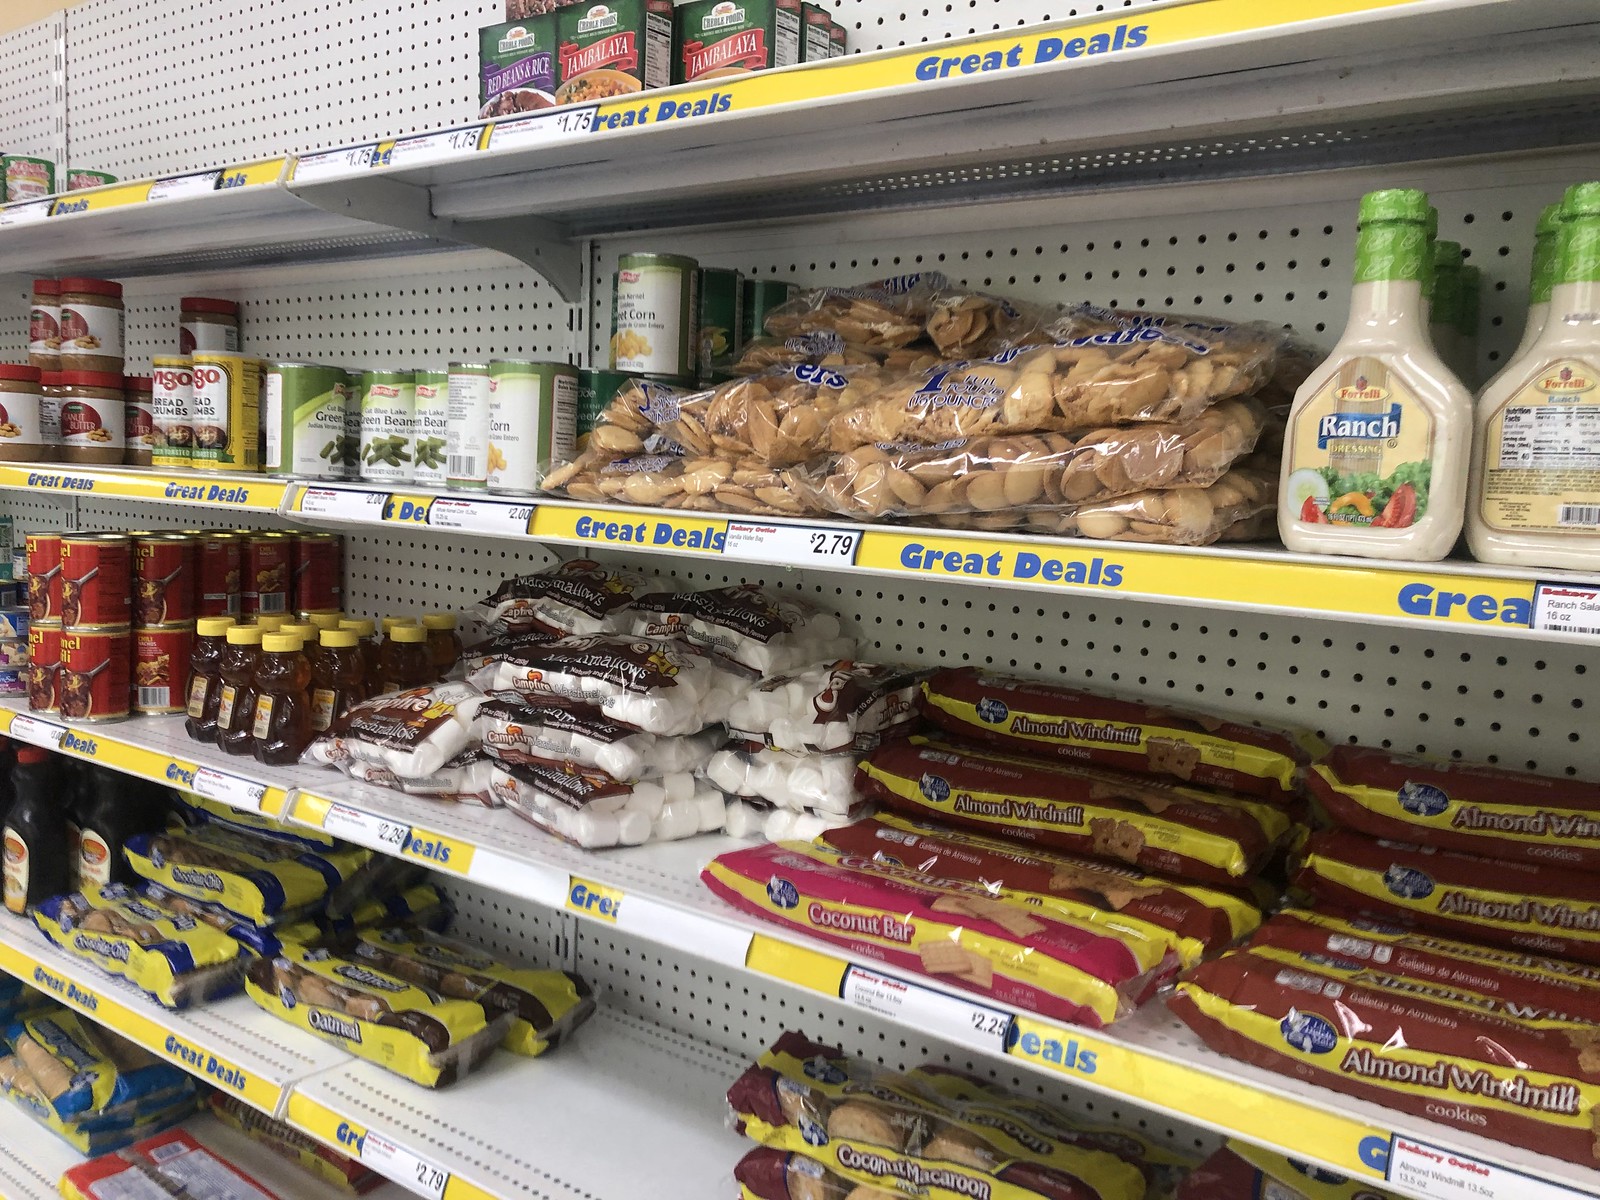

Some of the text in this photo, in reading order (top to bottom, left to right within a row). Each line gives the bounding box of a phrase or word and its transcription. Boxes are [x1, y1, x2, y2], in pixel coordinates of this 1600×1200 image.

[567, 36, 629, 79] JAMBALAYA
[691, 33, 757, 77] JAMBALAYA
[915, 24, 1149, 81] Great Deals
[487, 75, 501, 94] RED
[502, 66, 523, 89] BEANS
[531, 57, 550, 78] RICE
[557, 111, 592, 133] $1.75
[591, 92, 732, 132] reat Deals
[448, 130, 478, 150] $1.75
[346, 149, 372, 166] $1.75
[218, 173, 248, 189] eals
[629, 309, 656, 321] Corn
[793, 363, 849, 389] ers
[154, 398, 184, 407] BREAD
[390, 408, 408, 416] Lake
[429, 409, 445, 417] Lake
[490, 418, 511, 432] Corn
[1321, 415, 1399, 438] Ranch
[28, 472, 94, 491] Great Deals
[165, 482, 249, 503] Great Deals
[575, 516, 727, 550] Great Deals
[731, 525, 754, 533] Bakery
[810, 533, 853, 556] $2.79
[900, 543, 1124, 587] Great Deals
[1398, 583, 1532, 625] Grea
[1542, 588, 1597, 600] Bakery
[1547, 600, 1600, 611] Ranch Sala
[1547, 612, 1572, 622] 16 oz
[61, 636, 80, 650] mel
[512, 676, 551, 692] Campfire
[1011, 717, 1142, 746] Almond Windmill
[65, 734, 97, 755] Deals
[1057, 746, 1091, 760] cookies
[166, 763, 195, 785] Gre
[954, 797, 1084, 825] Almond Windmill
[1452, 806, 1548, 834] Almond
[1001, 827, 1036, 841] cookies
[951, 850, 983, 866] Almendra
[1527, 846, 1583, 863] cookies
[571, 884, 619, 918] Gre
[1437, 891, 1531, 921] Almond
[808, 903, 914, 945] Coconut Bar
[33, 966, 99, 1012] Great Deals
[852, 969, 908, 993] Bakery Outlet
[1451, 970, 1500, 991] Almendra
[1350, 991, 1458, 1029] Galletas de Almendra
[308, 1008, 362, 1044] Oatmeal
[971, 1012, 1006, 1038] $2.25
[165, 1035, 247, 1091] Great Deals
[1342, 1048, 1580, 1116] Almond Windmill
[1425, 1102, 1489, 1128] cookies
[1398, 1140, 1445, 1164] Bakery
[1448, 1157, 1490, 1178] Outlet
[416, 1161, 446, 1191] $2.79
[837, 1143, 906, 1177] Coconut
[906, 1161, 993, 1199] Macaroon
[1399, 1161, 1495, 1198] Almond Windmill 13.5oz
[1399, 1172, 1428, 1189] 13.5 oz
